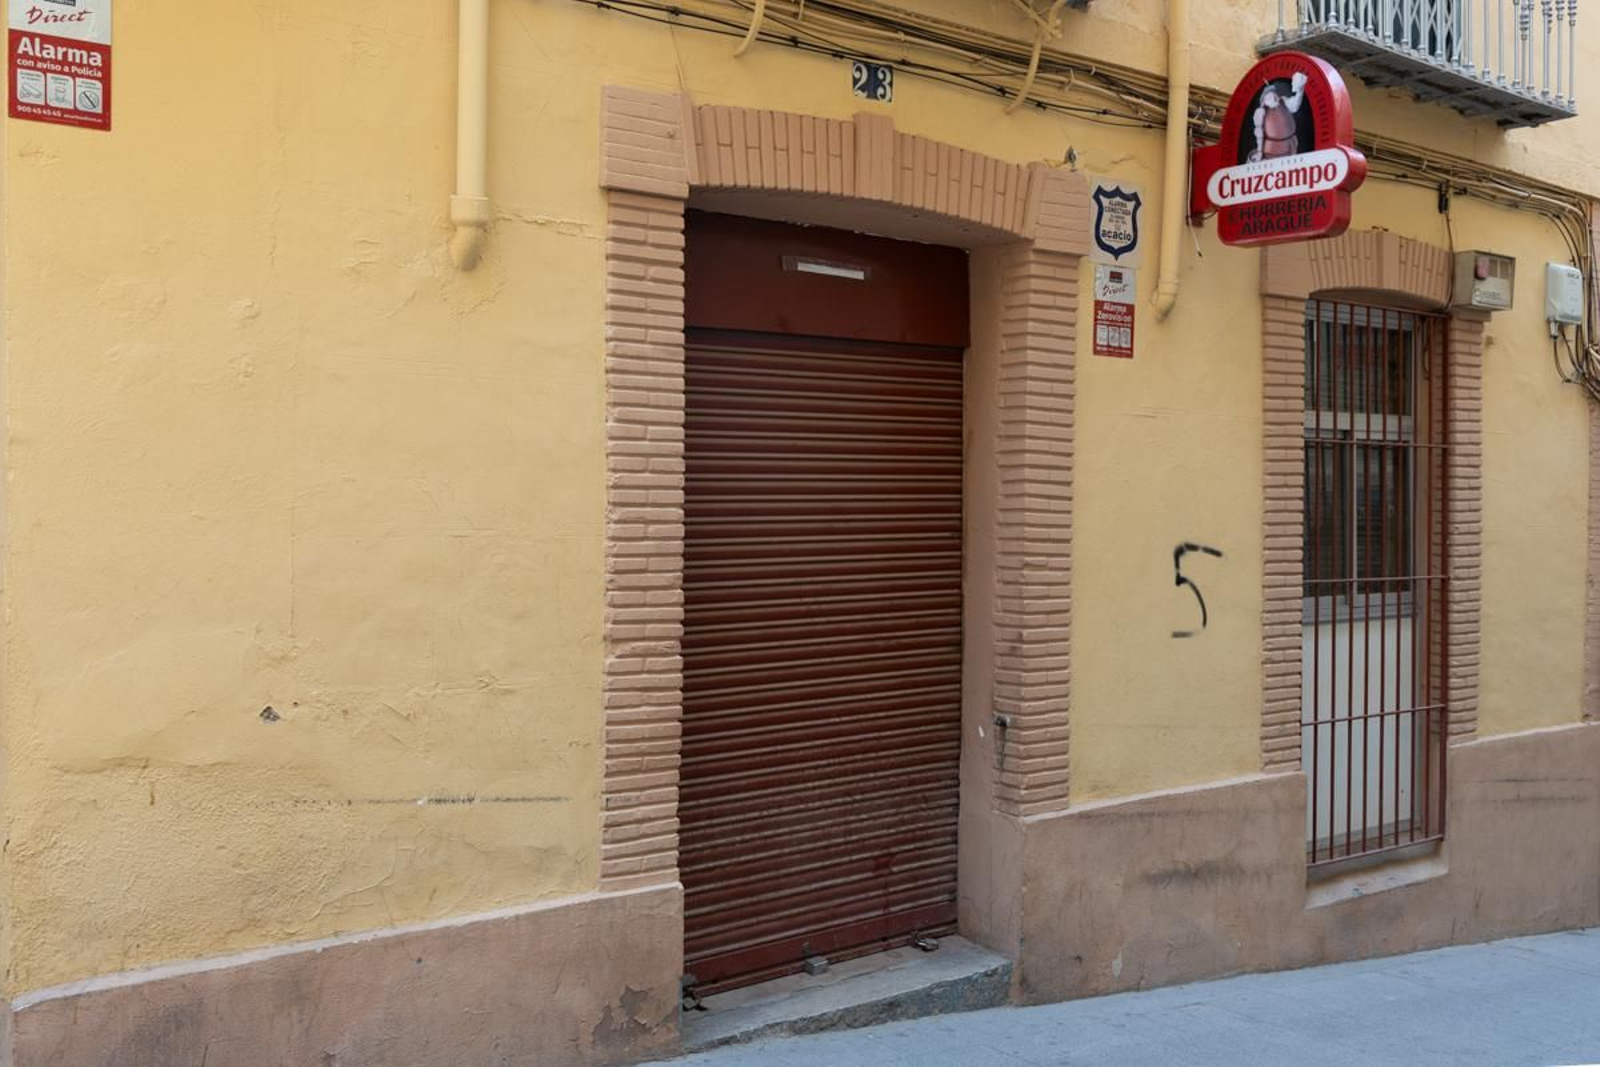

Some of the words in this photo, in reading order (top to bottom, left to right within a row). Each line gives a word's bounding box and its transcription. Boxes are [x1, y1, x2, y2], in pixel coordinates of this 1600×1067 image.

[25, 6, 95, 24] Direct
[17, 37, 102, 67] Alarma
[16, 58, 34, 67] con
[36, 60, 62, 72] aviso
[63, 65, 70, 73] a
[853, 63, 891, 102] 23
[1218, 161, 1337, 199] Cruzcampo
[1101, 229, 1132, 241] acacio
[1240, 212, 1313, 235] ARAQUE
